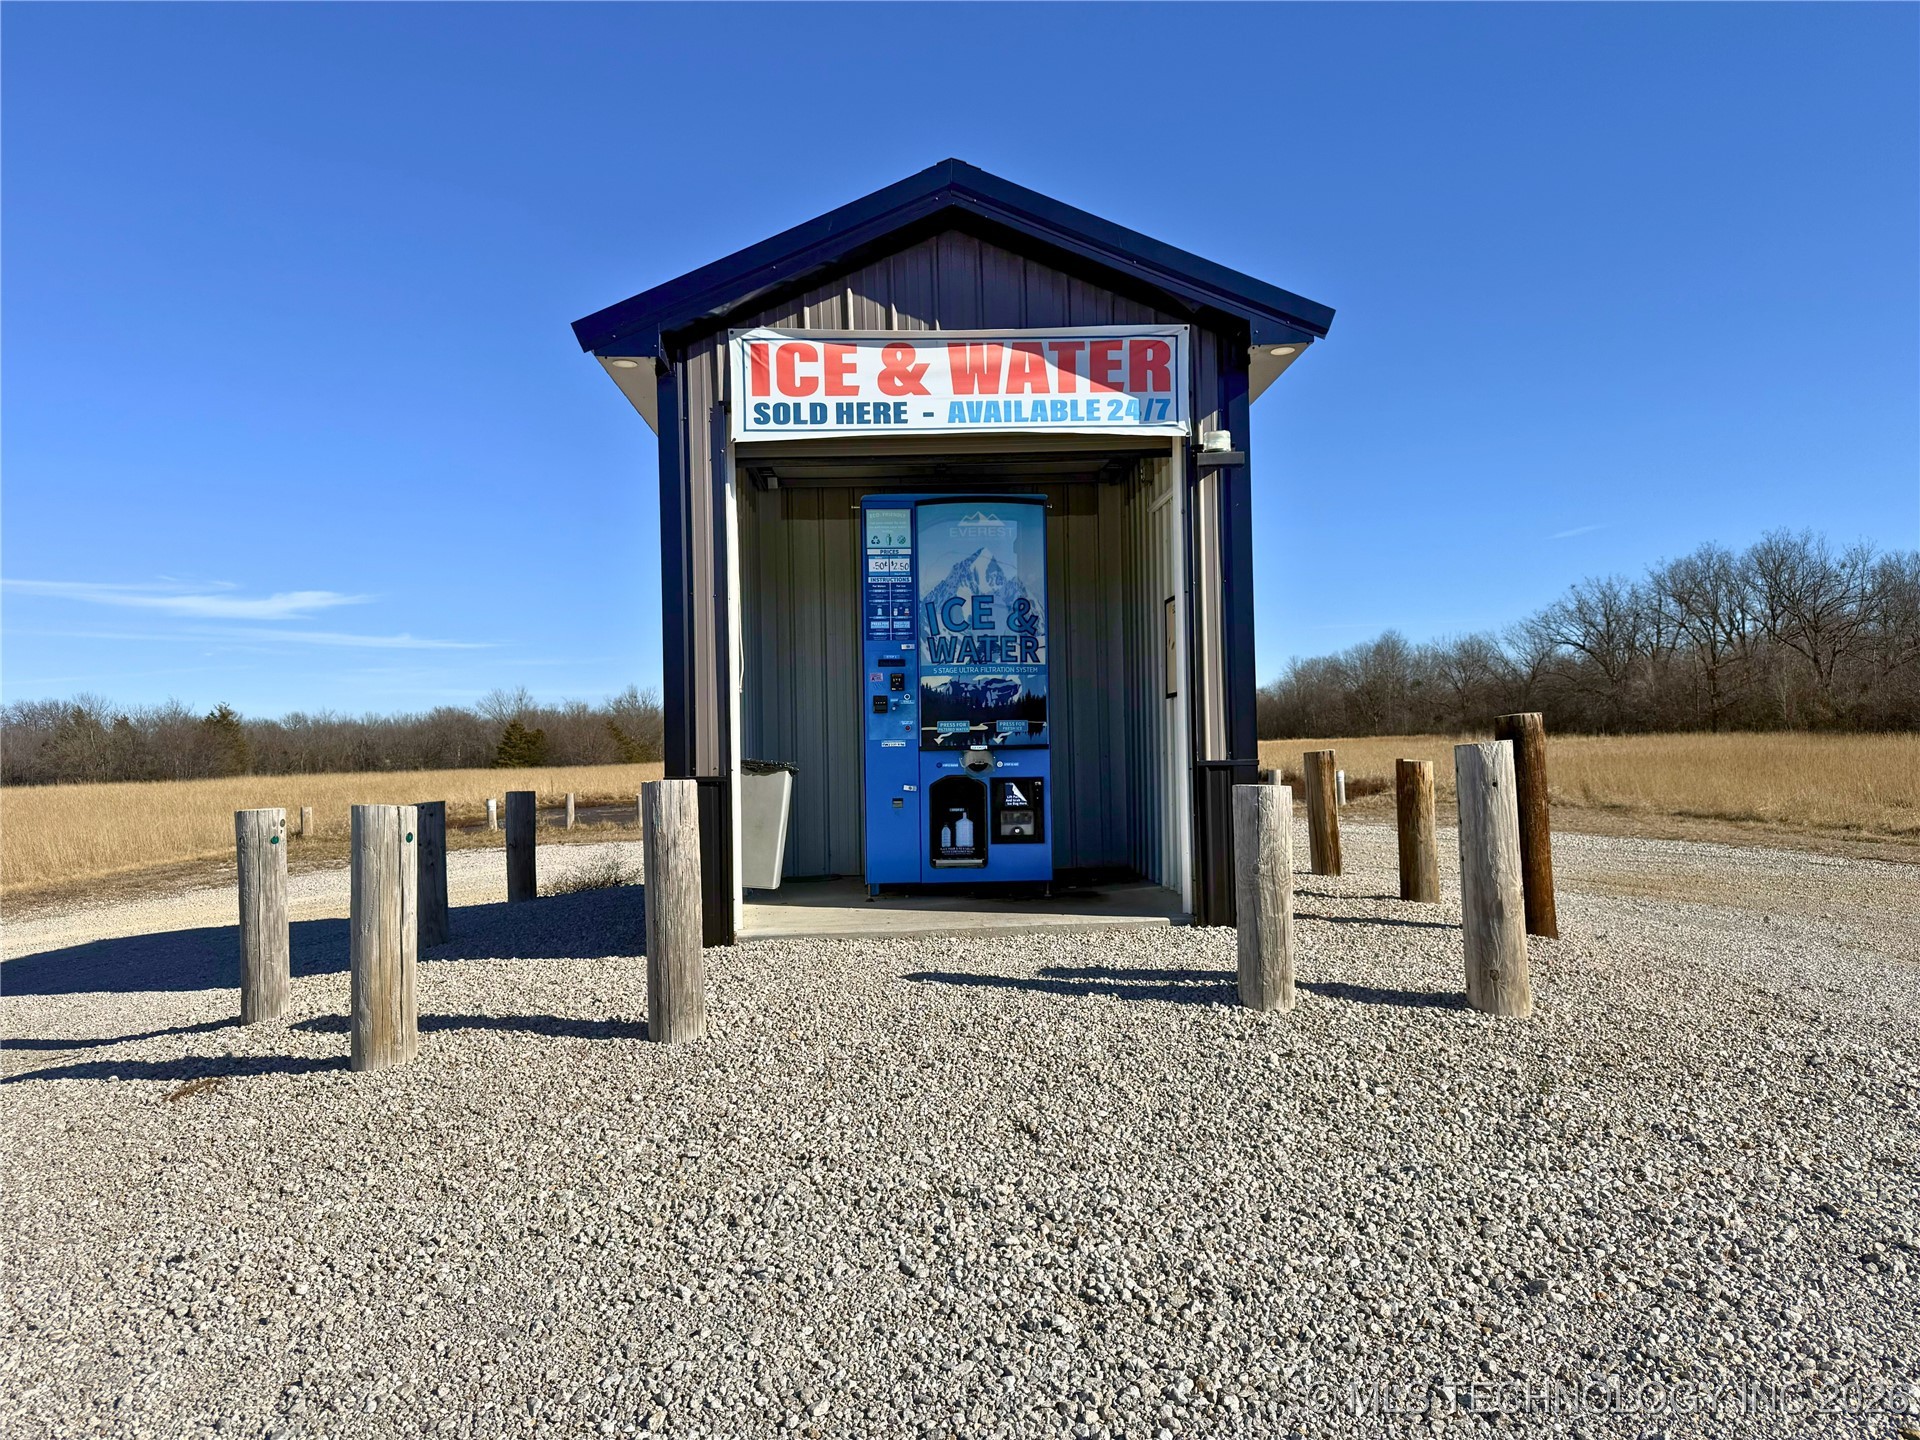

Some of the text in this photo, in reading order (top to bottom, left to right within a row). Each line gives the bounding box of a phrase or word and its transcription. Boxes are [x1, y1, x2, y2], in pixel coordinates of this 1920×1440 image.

[750, 339, 1171, 397] ICE & WATER
[754, 402, 827, 426] SOLD
[835, 401, 908, 425] HERE
[947, 398, 1100, 424] AVAILABLE
[1107, 397, 1171, 423] 24/7
[949, 526, 1014, 537] EVEREST
[891, 561, 910, 571] $2.50
[925, 595, 1039, 636] ICE &
[927, 635, 1040, 664] WATER
